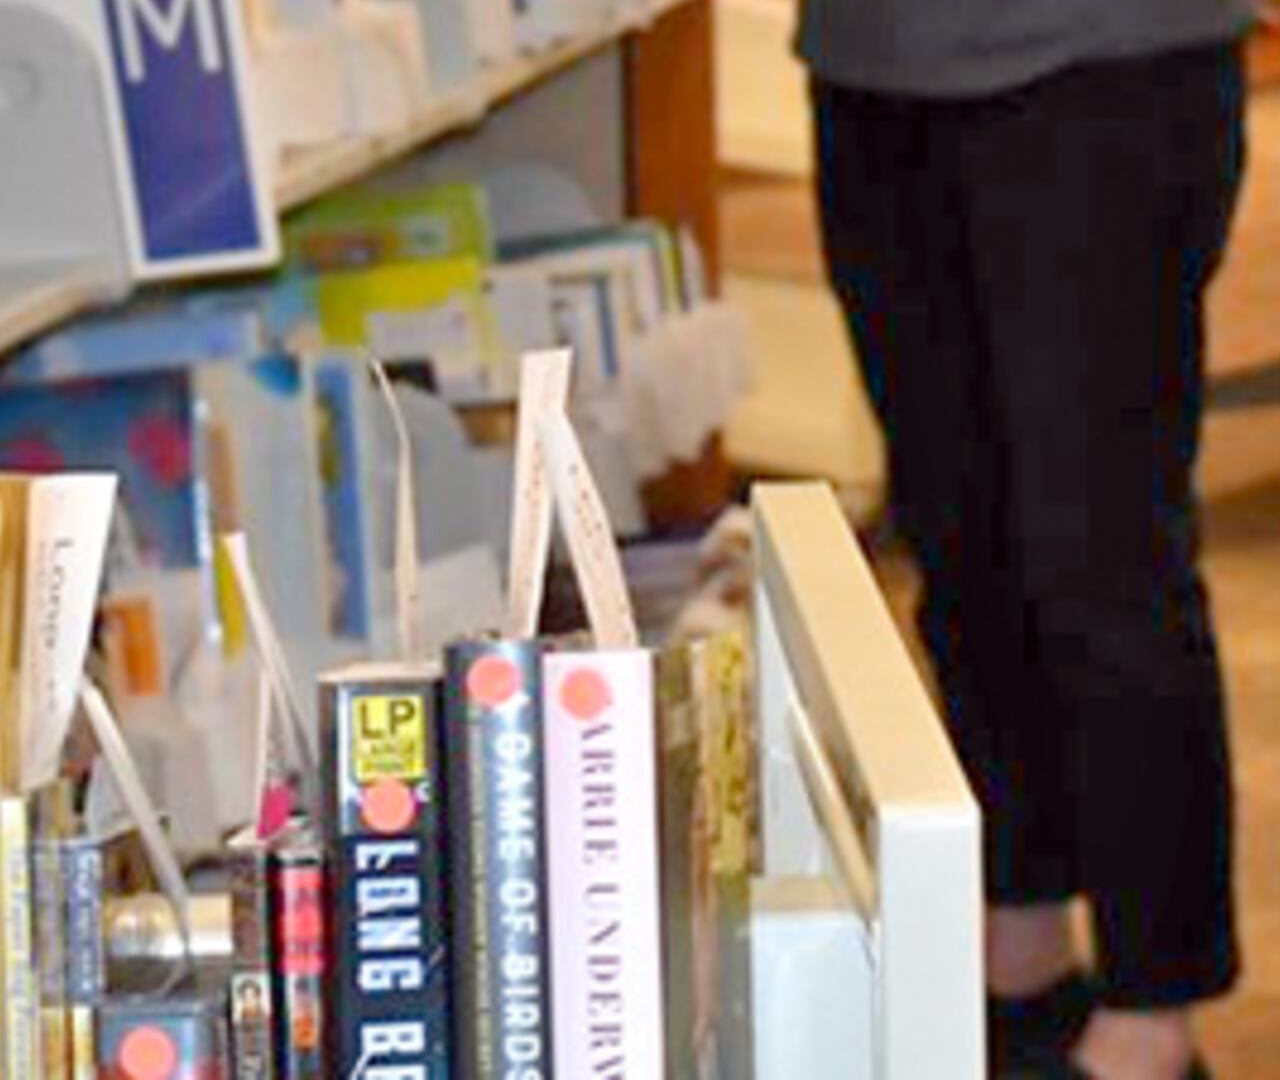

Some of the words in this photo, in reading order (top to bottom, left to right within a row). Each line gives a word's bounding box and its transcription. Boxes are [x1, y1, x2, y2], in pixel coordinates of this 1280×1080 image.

[360, 698, 415, 738] LP
[492, 732, 536, 860] GAME
[580, 722, 616, 865] ARRIE
[355, 842, 423, 994] LONG
[499, 875, 538, 937] OF
